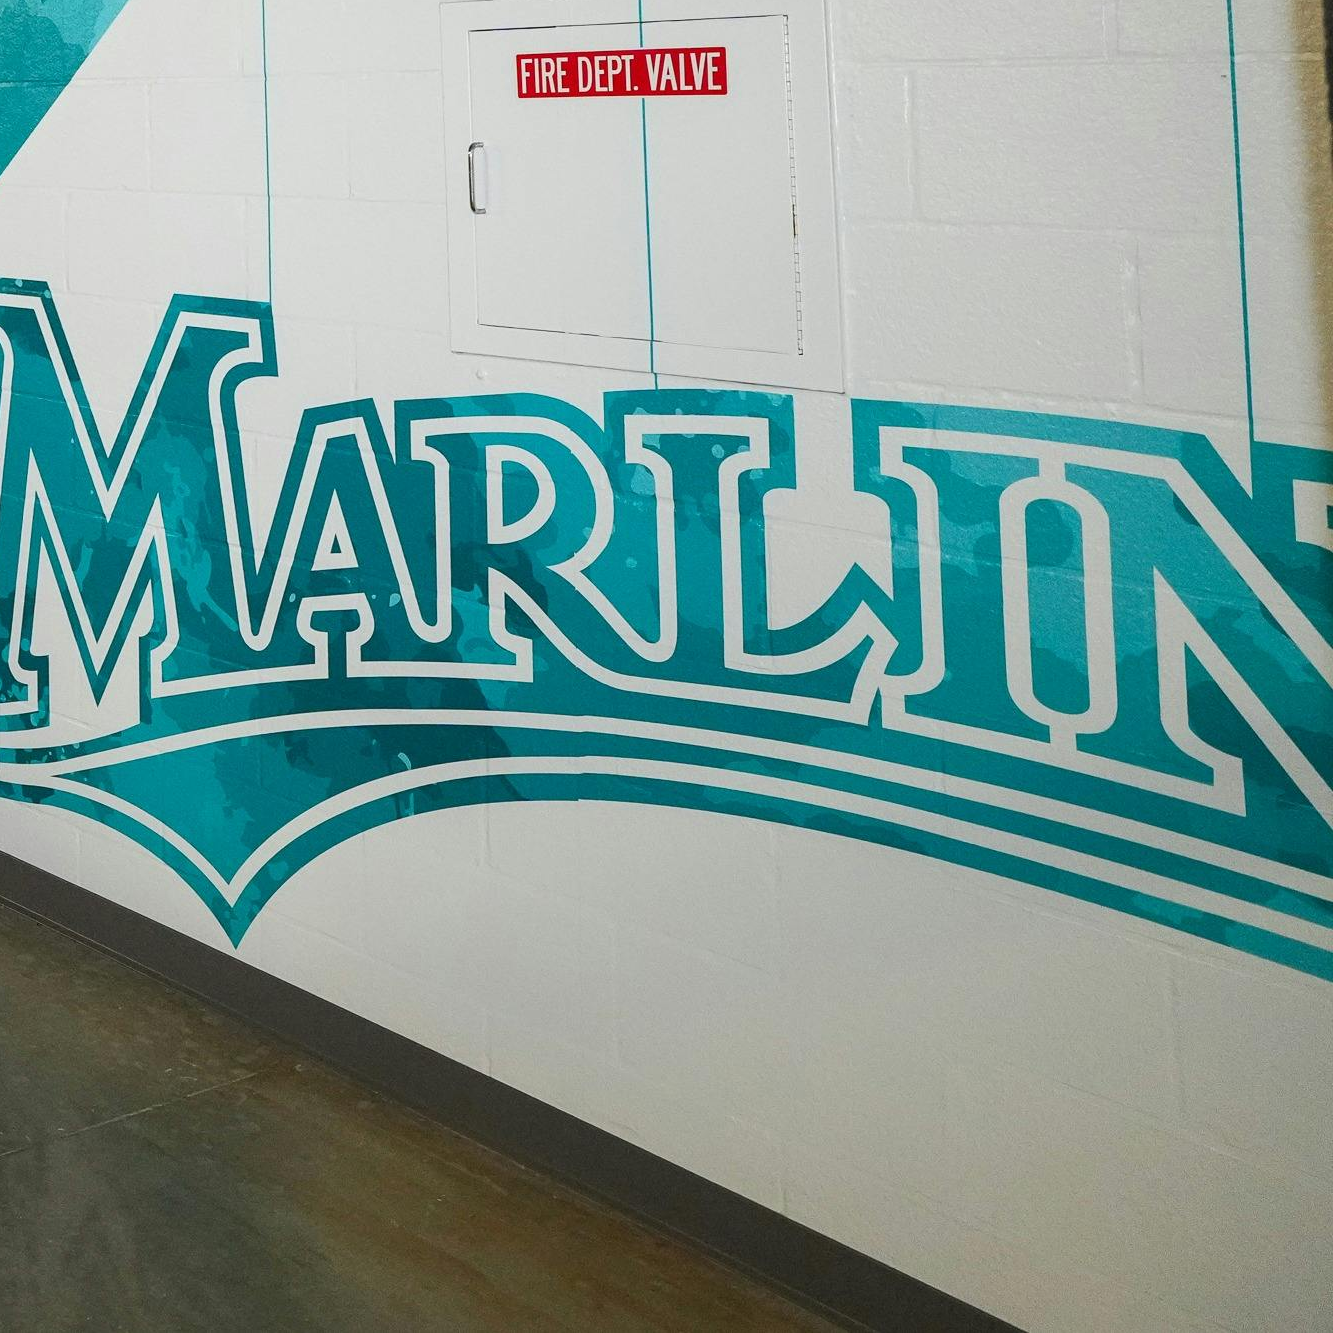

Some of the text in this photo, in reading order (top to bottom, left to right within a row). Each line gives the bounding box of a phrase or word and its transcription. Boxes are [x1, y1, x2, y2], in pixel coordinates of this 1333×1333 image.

[520, 51, 723, 94] FIRE DEPT. VALVE
